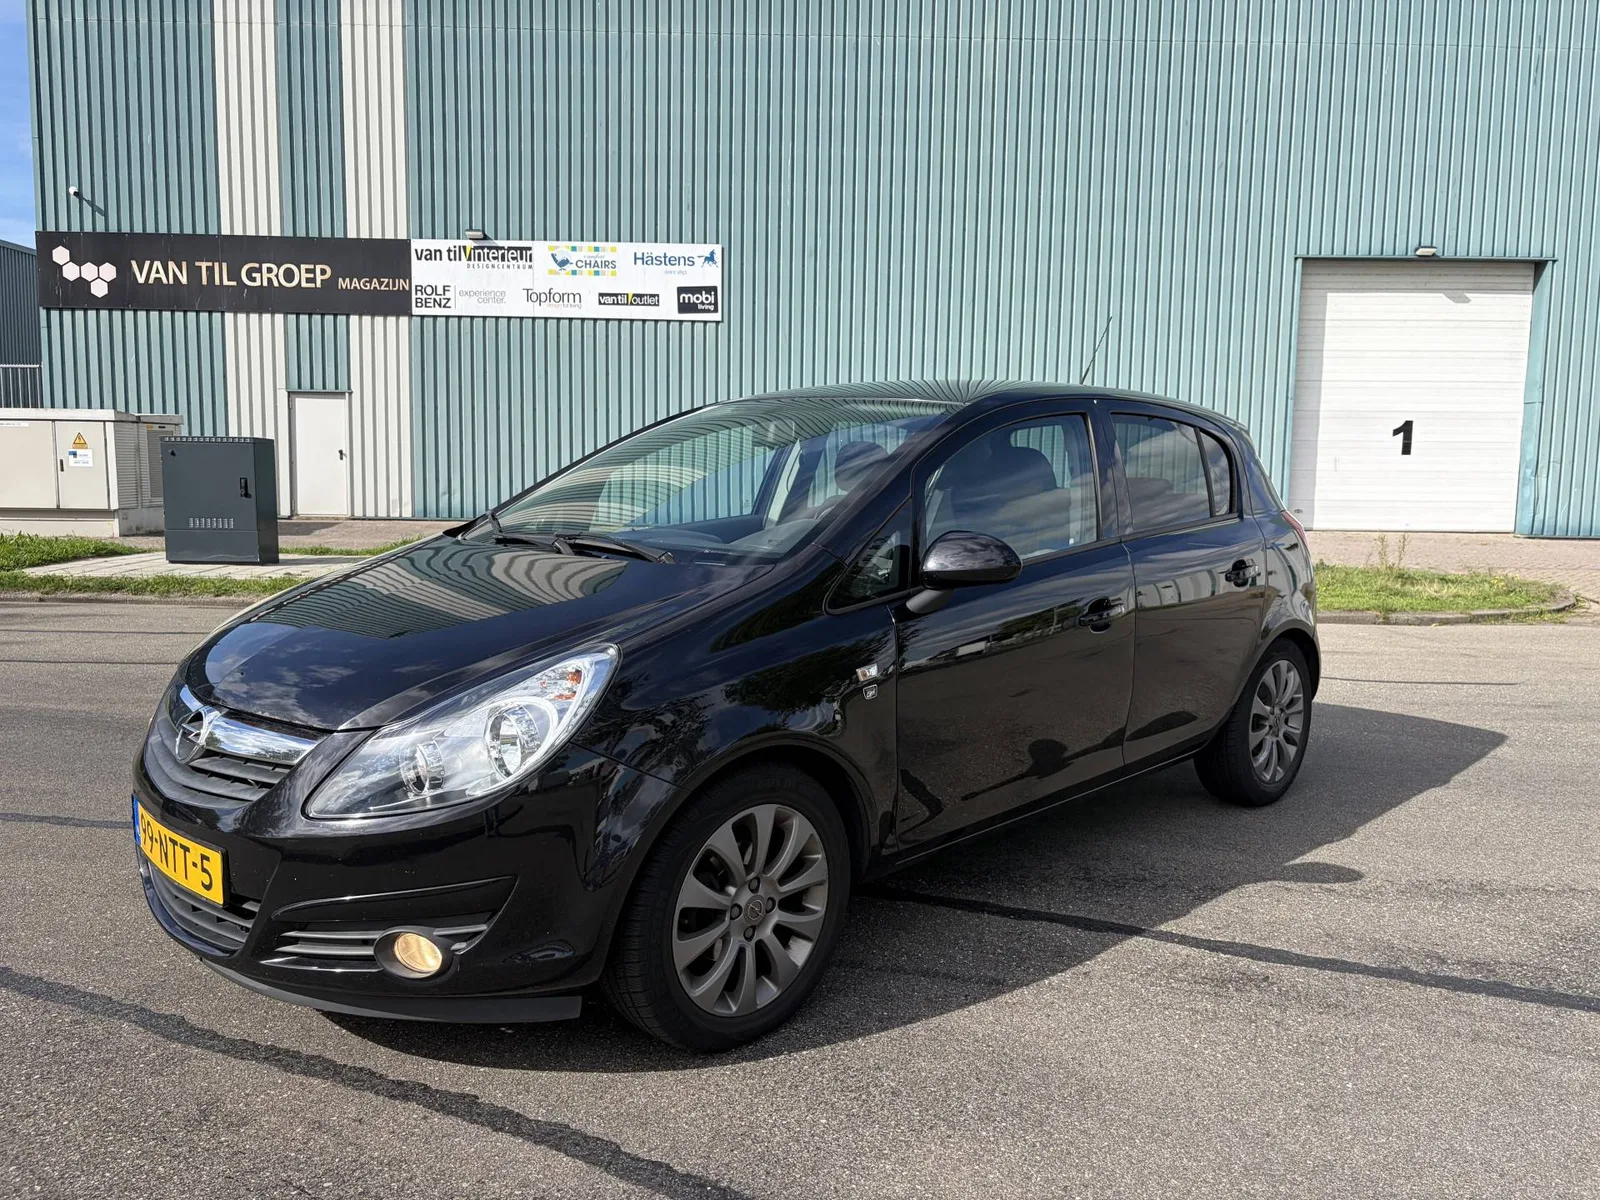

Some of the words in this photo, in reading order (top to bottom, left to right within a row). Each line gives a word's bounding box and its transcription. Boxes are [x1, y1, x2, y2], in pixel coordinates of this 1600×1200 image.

[414, 248, 443, 262] van
[446, 245, 462, 262] til
[471, 246, 532, 263] interieur
[633, 251, 696, 267] Hästens
[575, 259, 617, 270] CHAIRS
[130, 259, 188, 285] VAN
[194, 260, 238, 287] TIL
[240, 262, 332, 289] GROEP
[337, 277, 410, 292] MAGAZIJN
[414, 284, 452, 297] ROLF
[458, 289, 507, 299] experience
[522, 287, 582, 306] Topform
[679, 290, 715, 304] mobi
[414, 297, 452, 309] BENZ
[631, 296, 659, 305] outlet
[697, 303, 715, 311] living
[1392, 420, 1414, 456] 1
[140, 812, 214, 892] 99-NTT-5
